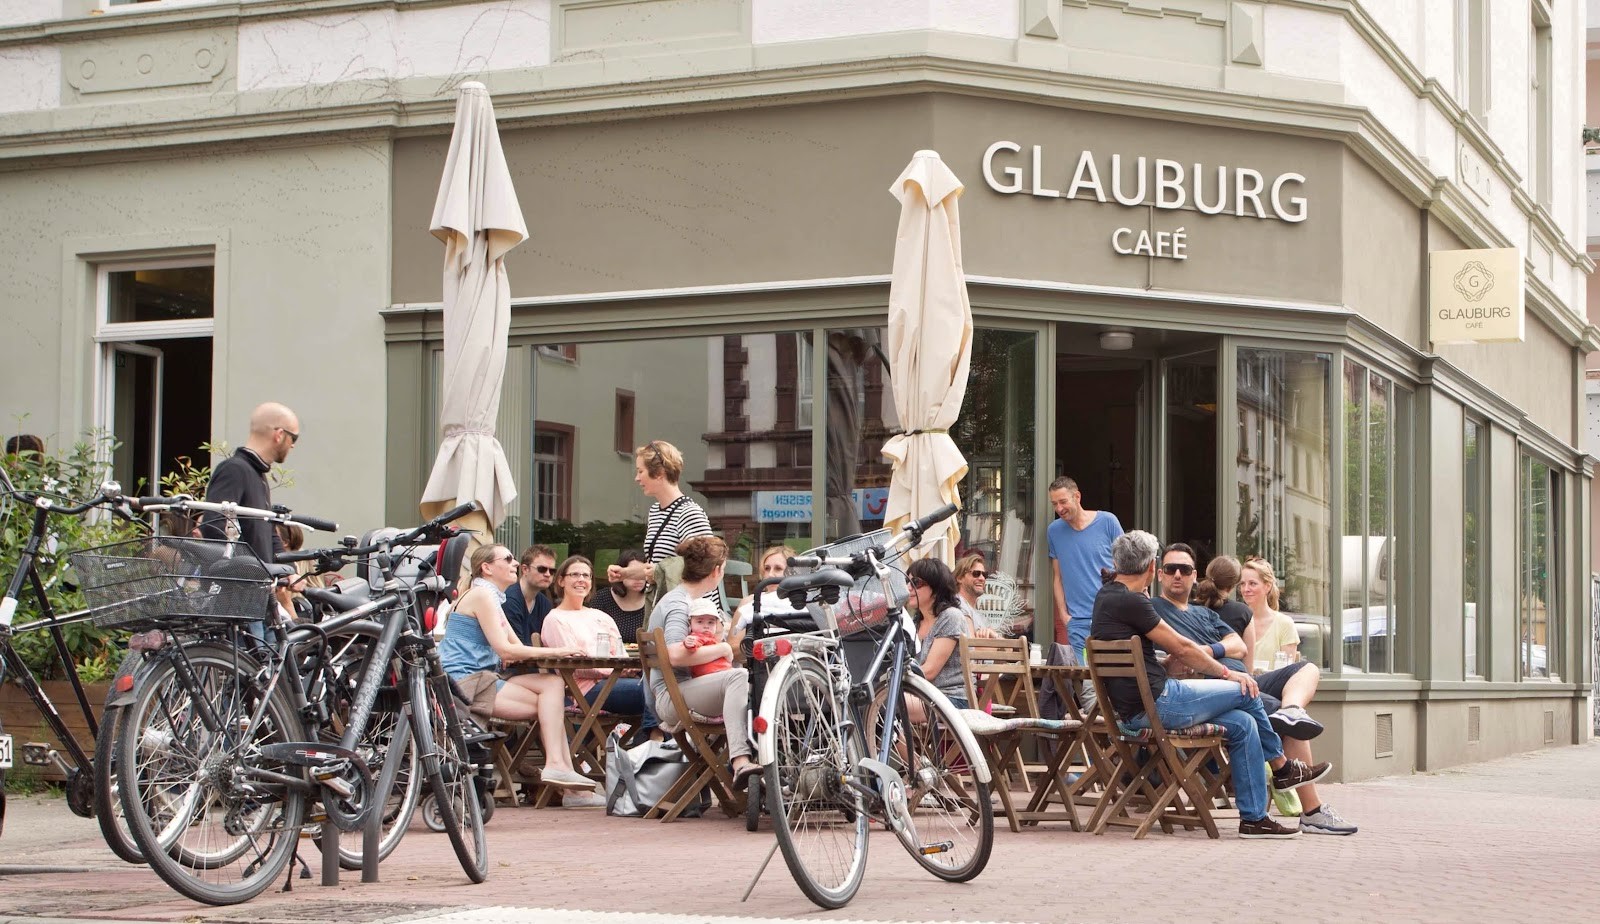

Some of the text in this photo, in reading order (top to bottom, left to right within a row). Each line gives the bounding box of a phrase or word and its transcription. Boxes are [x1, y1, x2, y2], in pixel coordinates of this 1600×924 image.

[982, 140, 1308, 223] GLAUBURG
[1111, 227, 1188, 260] CAFÉ
[1468, 275, 1479, 288] G
[1438, 306, 1511, 320] GLAUBURG
[1465, 321, 1484, 329] CAFÉ
